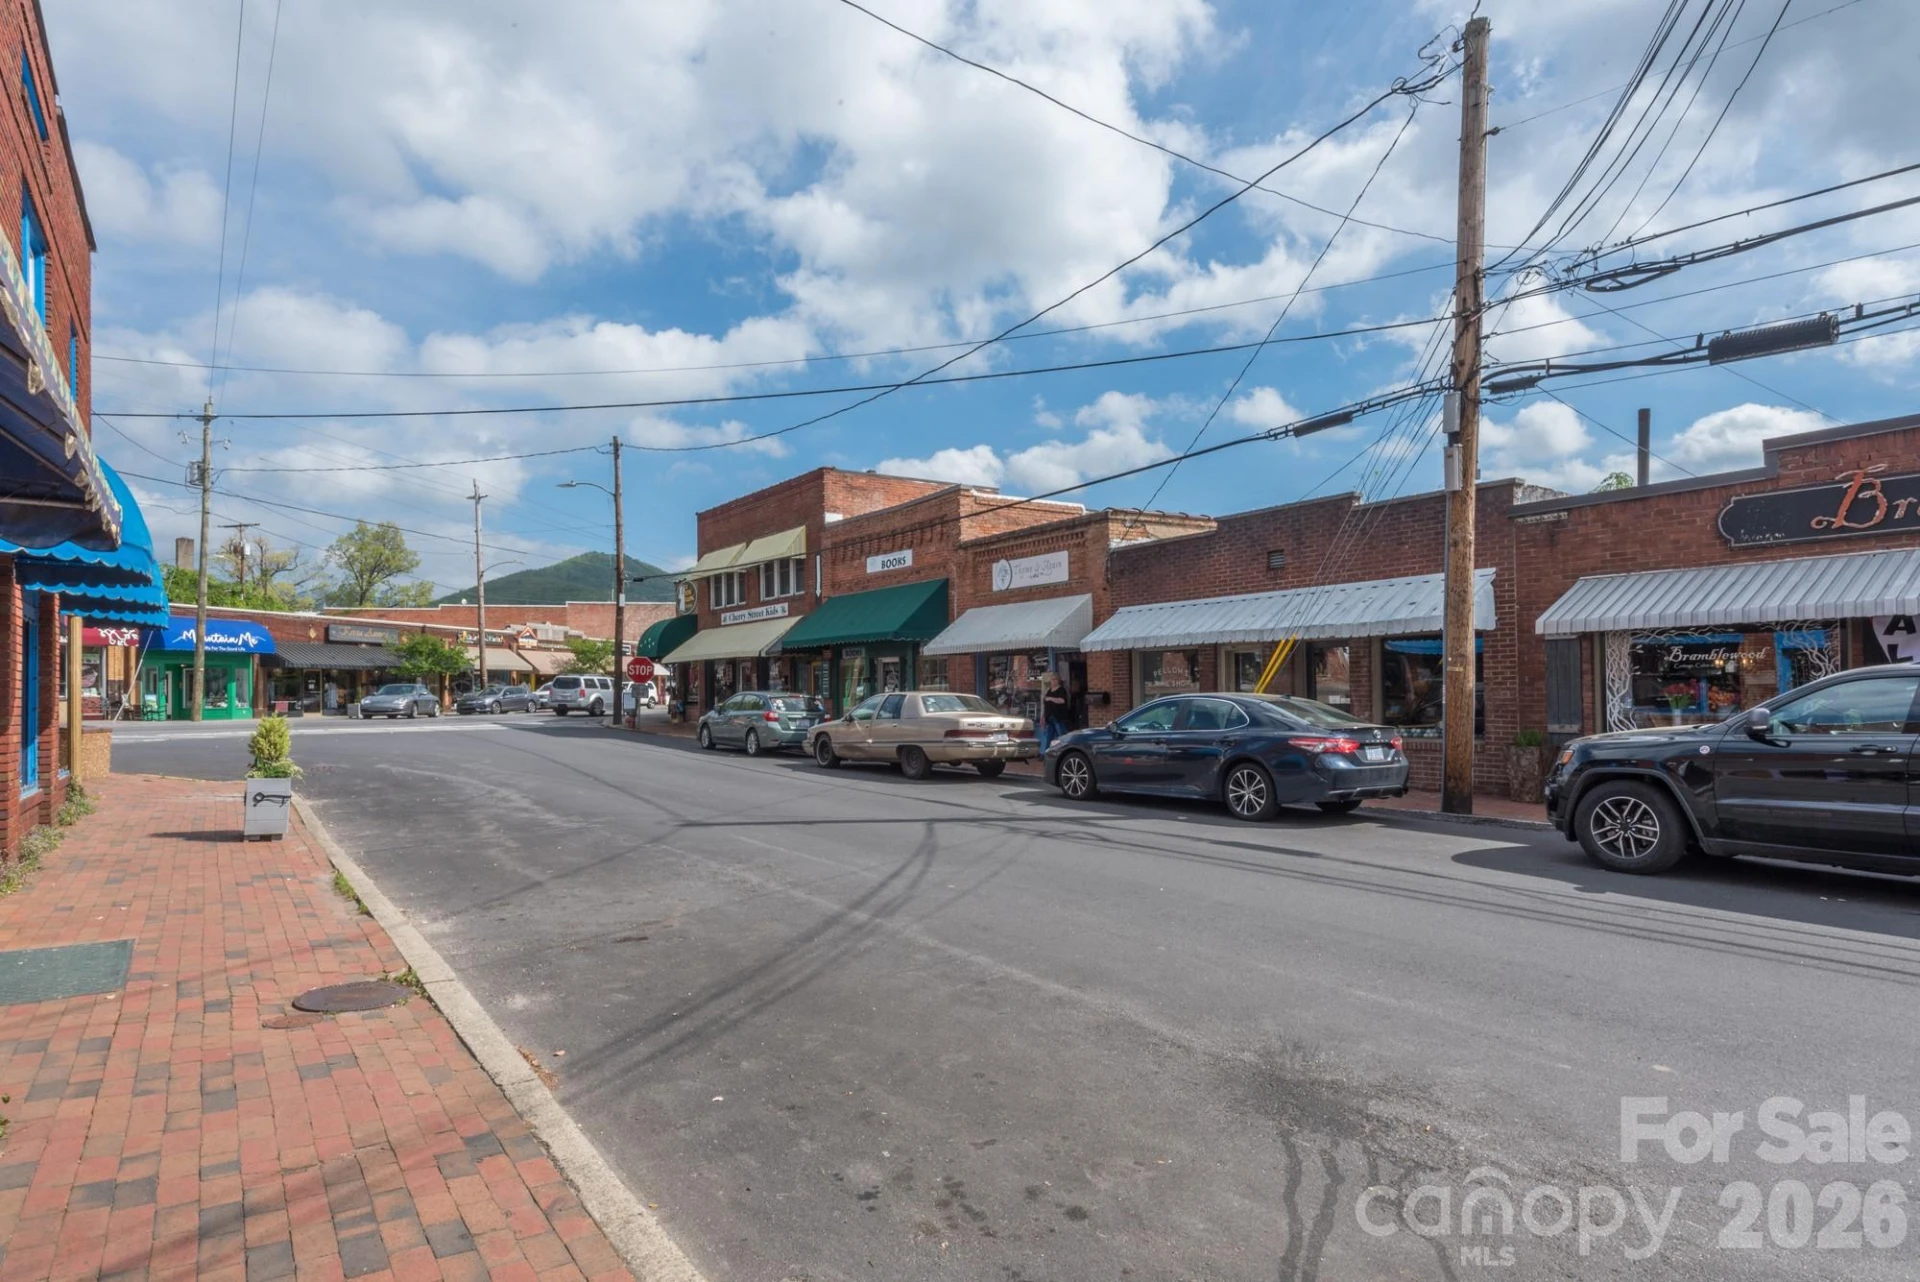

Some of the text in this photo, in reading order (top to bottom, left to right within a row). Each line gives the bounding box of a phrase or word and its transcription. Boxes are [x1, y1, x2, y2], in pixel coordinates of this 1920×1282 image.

[1810, 463, 1920, 530] Br
[881, 556, 906, 569] BOOKS
[728, 606, 779, 623] Cherry Street Kids
[182, 629, 239, 644] Muntain
[628, 665, 653, 676] STOP
